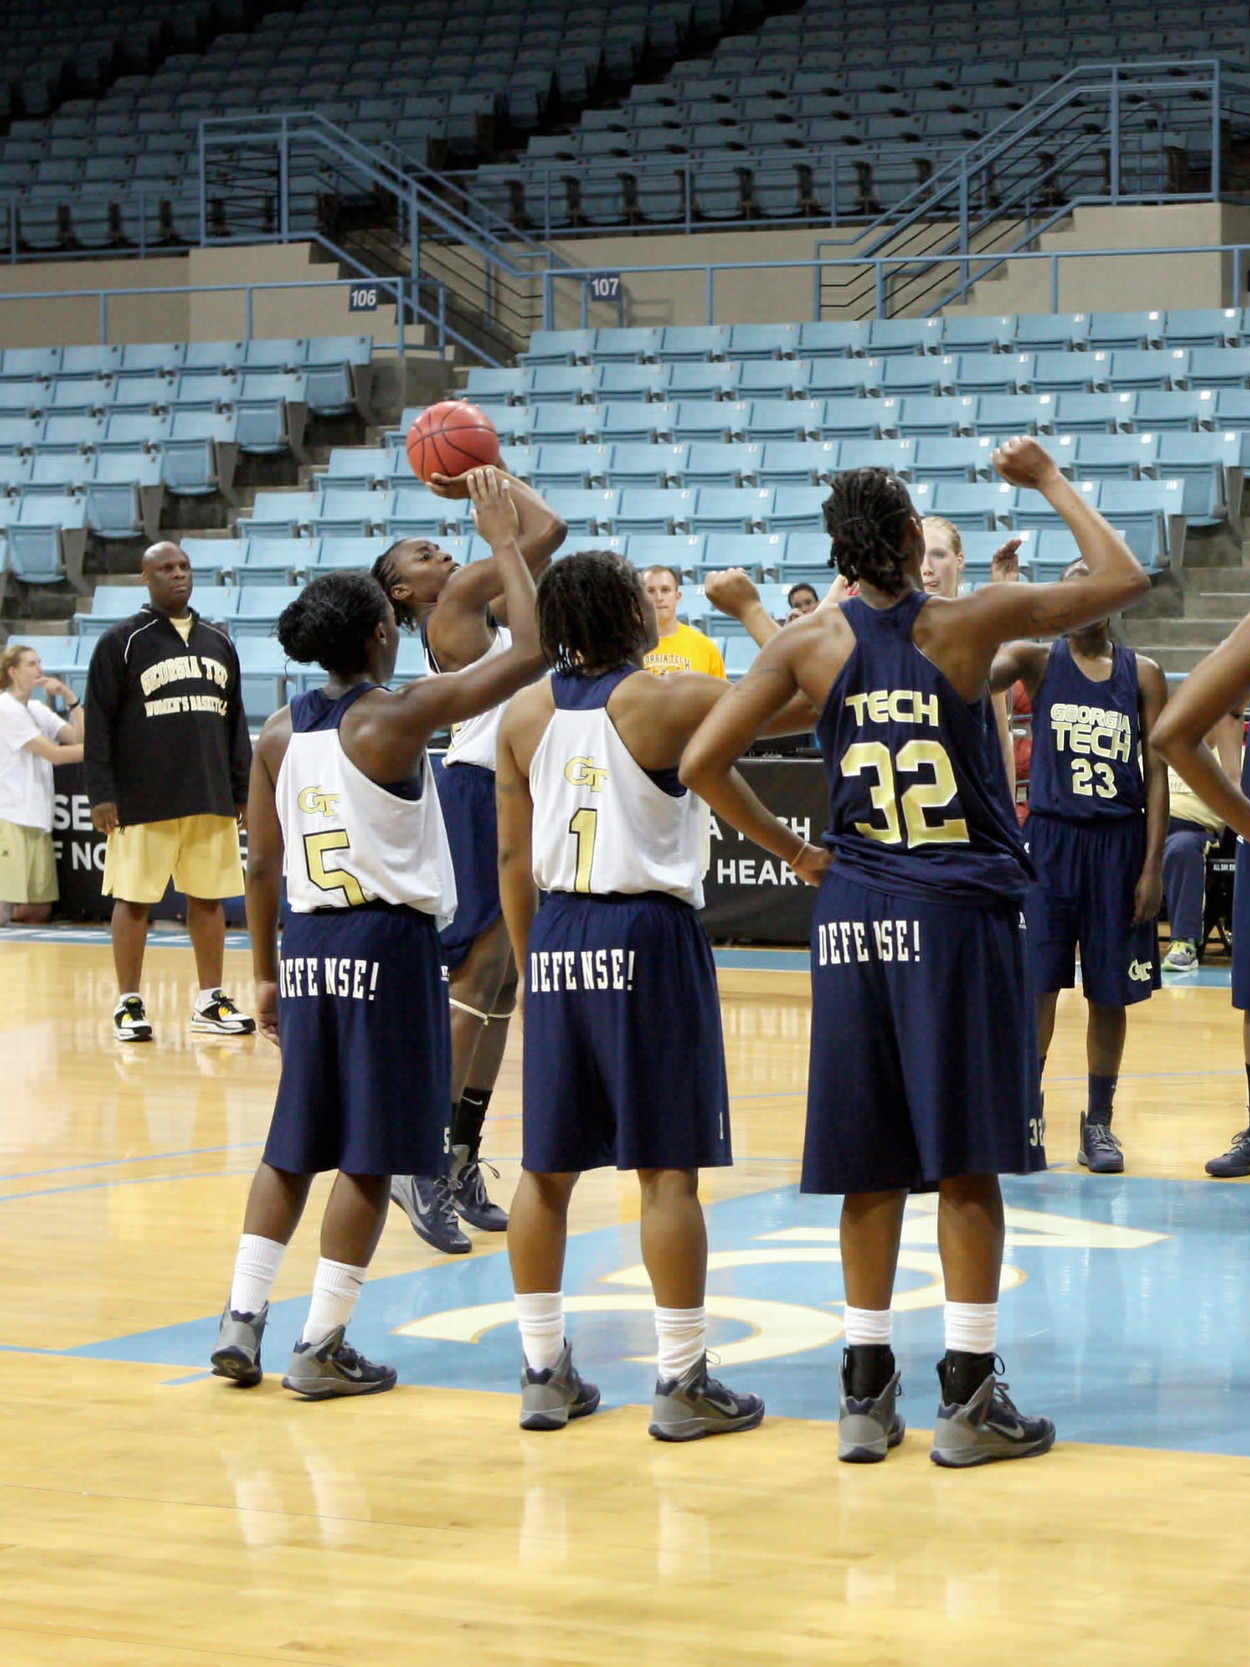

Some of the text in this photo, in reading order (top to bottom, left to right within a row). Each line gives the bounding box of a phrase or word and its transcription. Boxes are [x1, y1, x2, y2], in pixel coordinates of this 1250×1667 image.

[351, 289, 377, 307] 106
[591, 278, 620, 297] 107
[141, 656, 202, 696] GEORGIA
[845, 690, 939, 727] TECH
[1051, 703, 1131, 734] GEORGIA
[1051, 721, 1131, 763] TECH
[563, 756, 610, 793] GT
[1071, 758, 1117, 799] 23
[297, 785, 340, 817] GT
[840, 739, 970, 849] 32
[303, 828, 366, 907] 5
[569, 807, 597, 893] 1
[717, 859, 813, 887] HEAR
